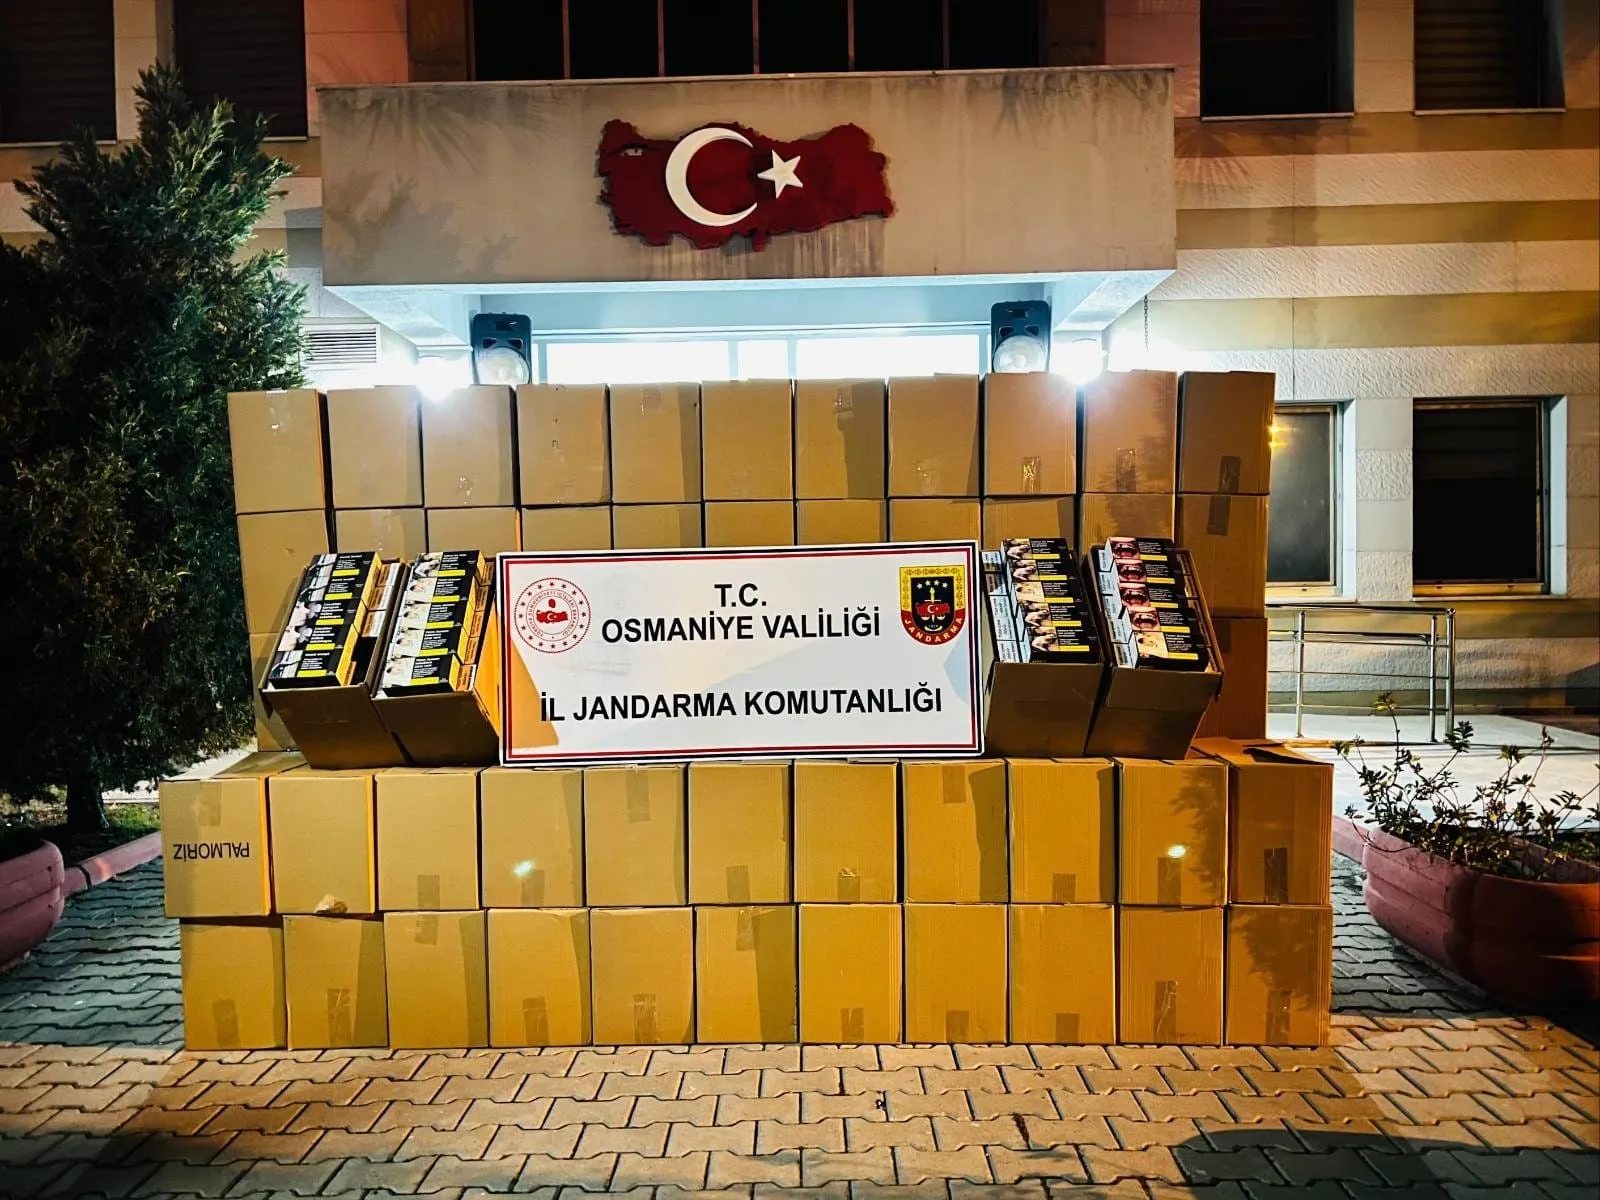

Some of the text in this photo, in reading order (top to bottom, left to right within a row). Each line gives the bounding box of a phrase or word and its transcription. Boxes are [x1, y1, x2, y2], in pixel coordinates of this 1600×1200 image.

[713, 582, 767, 608] T.C.
[601, 605, 881, 644] OSMANİYE VALİLİĞİ
[904, 617, 963, 643] JANDARMA
[541, 681, 943, 722] İL JANDARMA KOMUTANLIĞI
[172, 841, 251, 863] PALMORİZ
